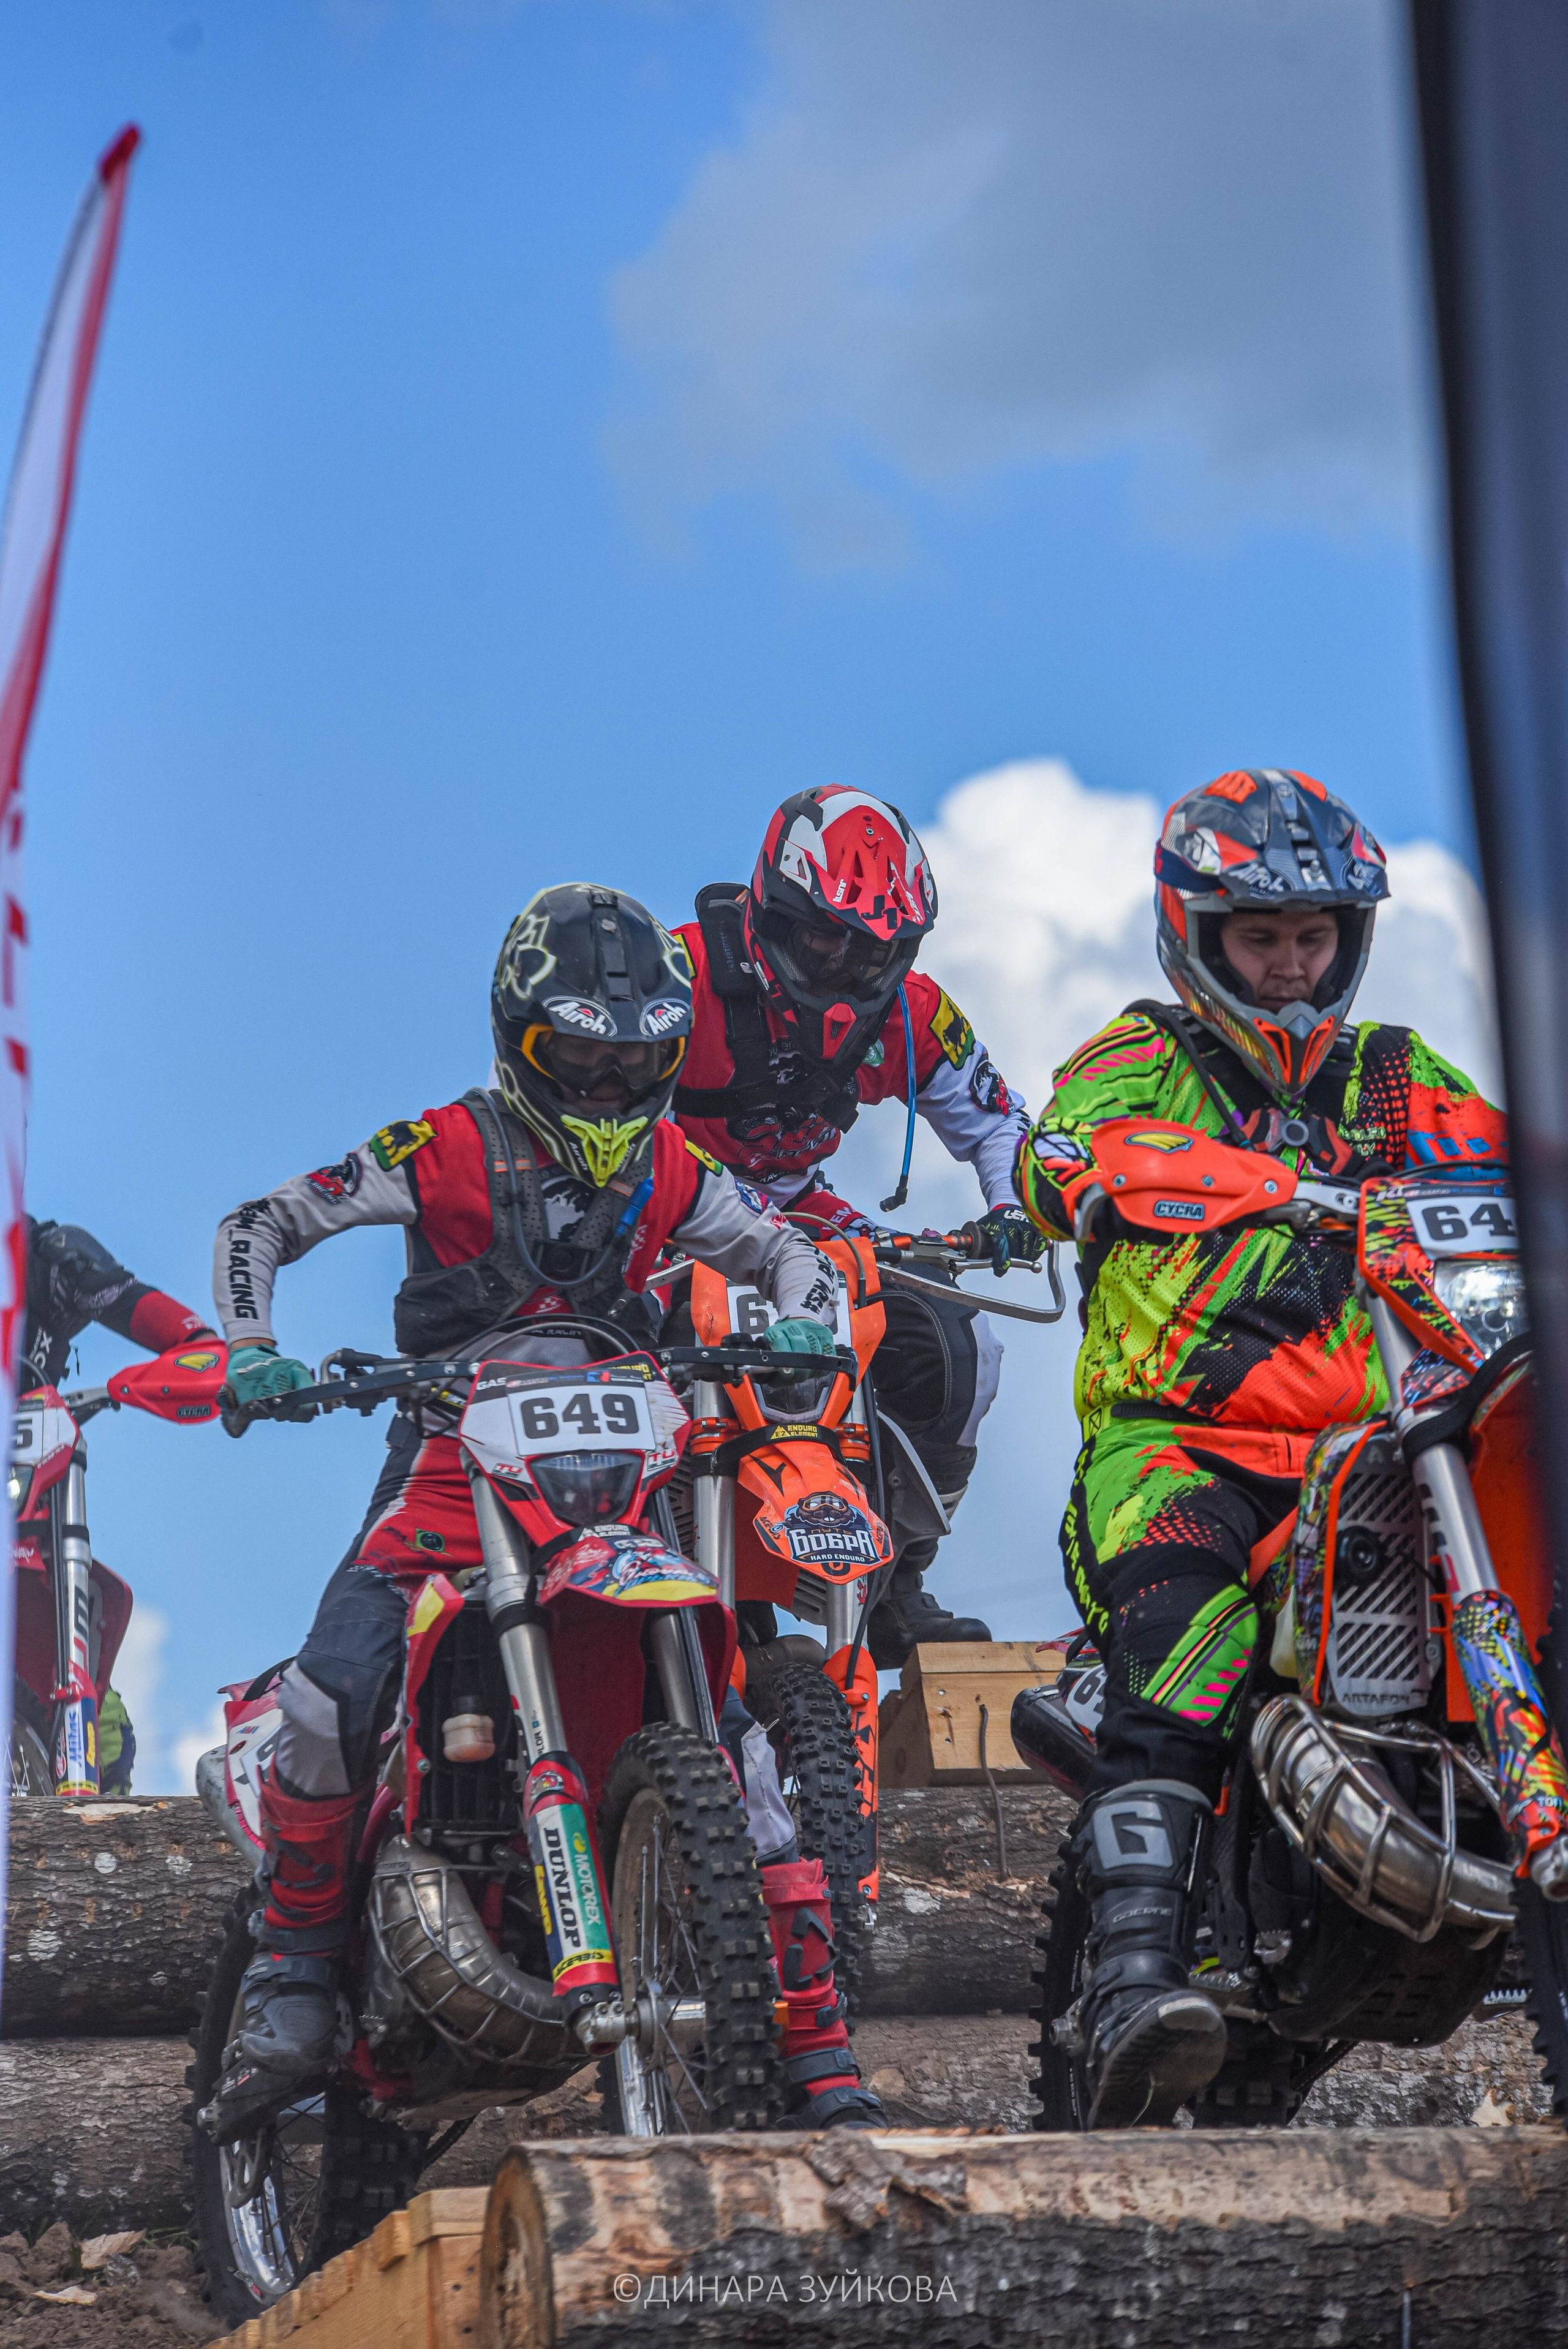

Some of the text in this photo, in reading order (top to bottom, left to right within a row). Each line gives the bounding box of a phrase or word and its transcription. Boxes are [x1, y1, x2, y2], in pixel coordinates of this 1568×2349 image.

[549, 1001, 606, 1035] Airoh
[646, 1002, 687, 1035] Airoh
[1157, 1203, 1203, 1216] CYCRA
[521, 1393, 639, 1439] 649
[790, 1529, 876, 1558] БОБРА
[543, 1827, 581, 1948] DUNLOP
[574, 1854, 601, 1925] MOTOREX
